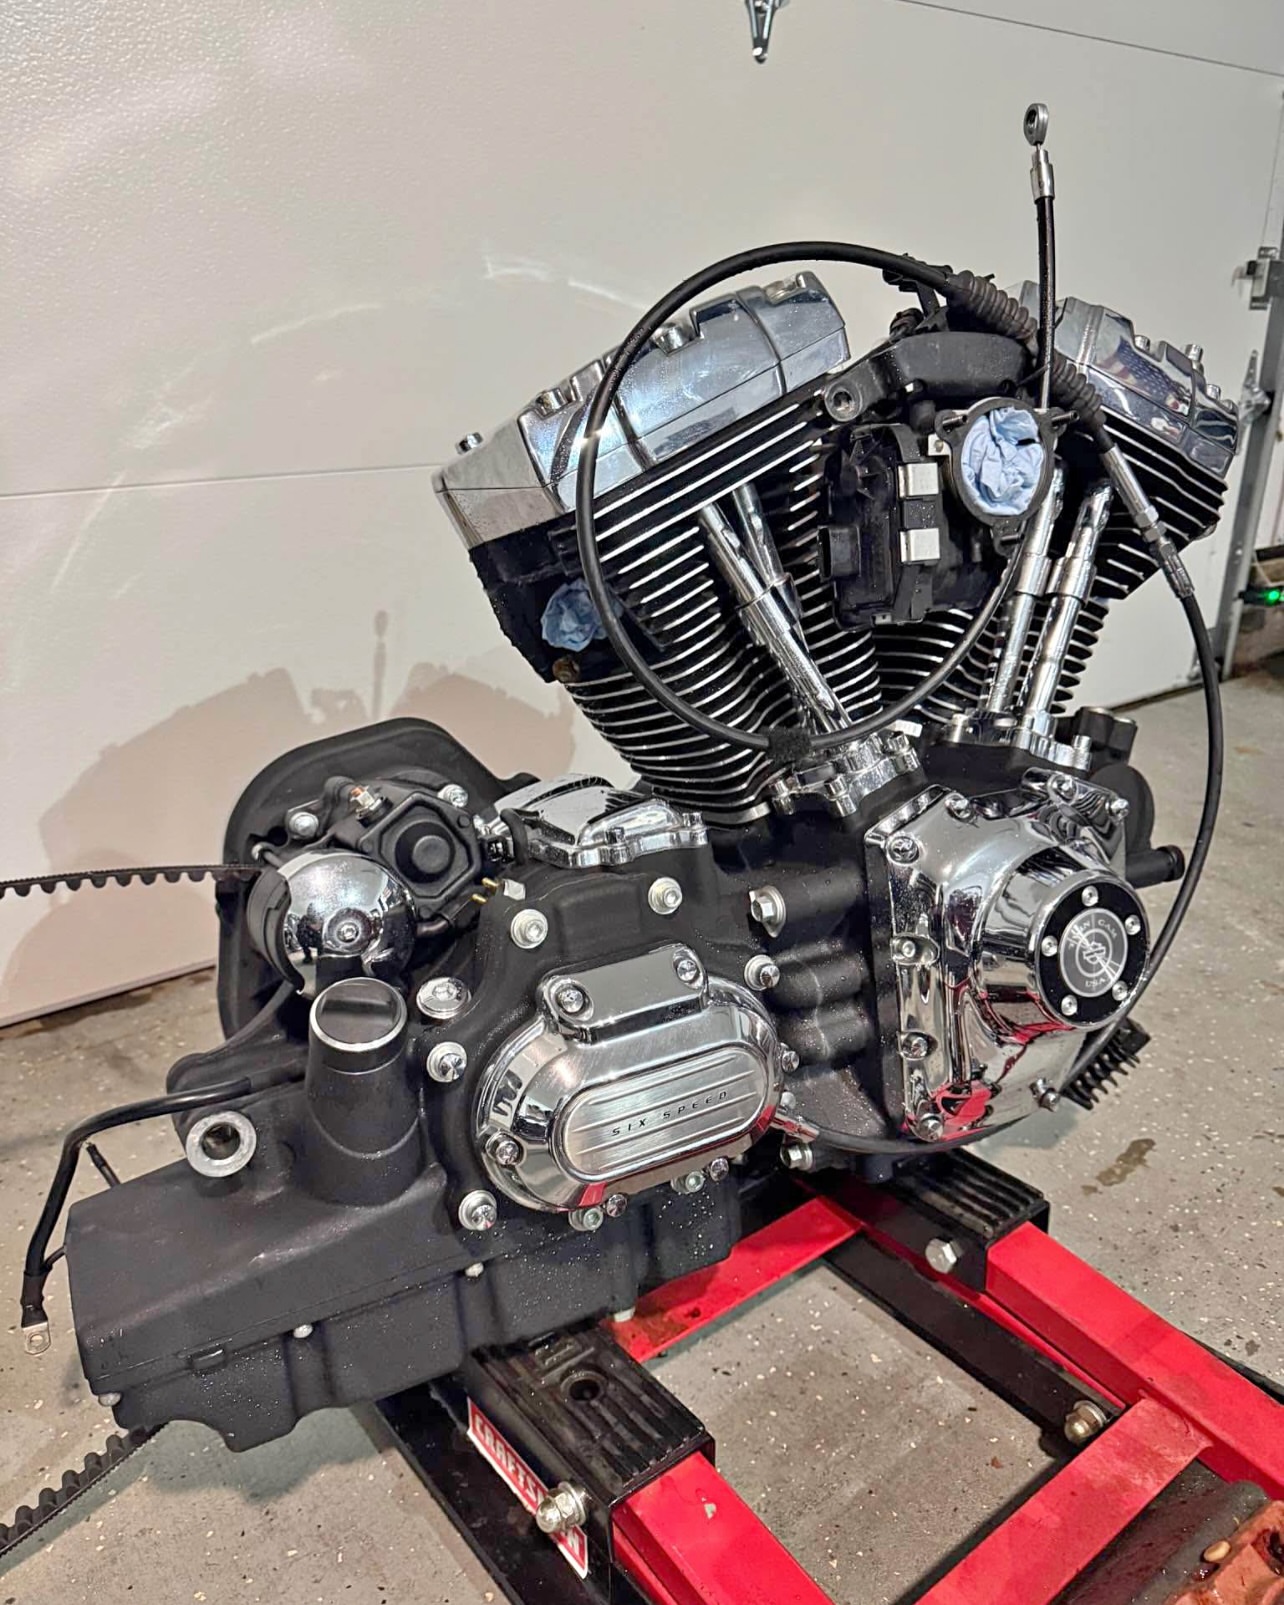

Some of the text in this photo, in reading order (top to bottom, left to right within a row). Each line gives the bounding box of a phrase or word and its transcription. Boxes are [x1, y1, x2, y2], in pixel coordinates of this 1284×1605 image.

[1098, 919, 1118, 939] CAM
[1085, 977, 1106, 988] USA
[612, 1091, 727, 1136] SIX SPEED
[475, 1413, 580, 1557] CRAFTSN
